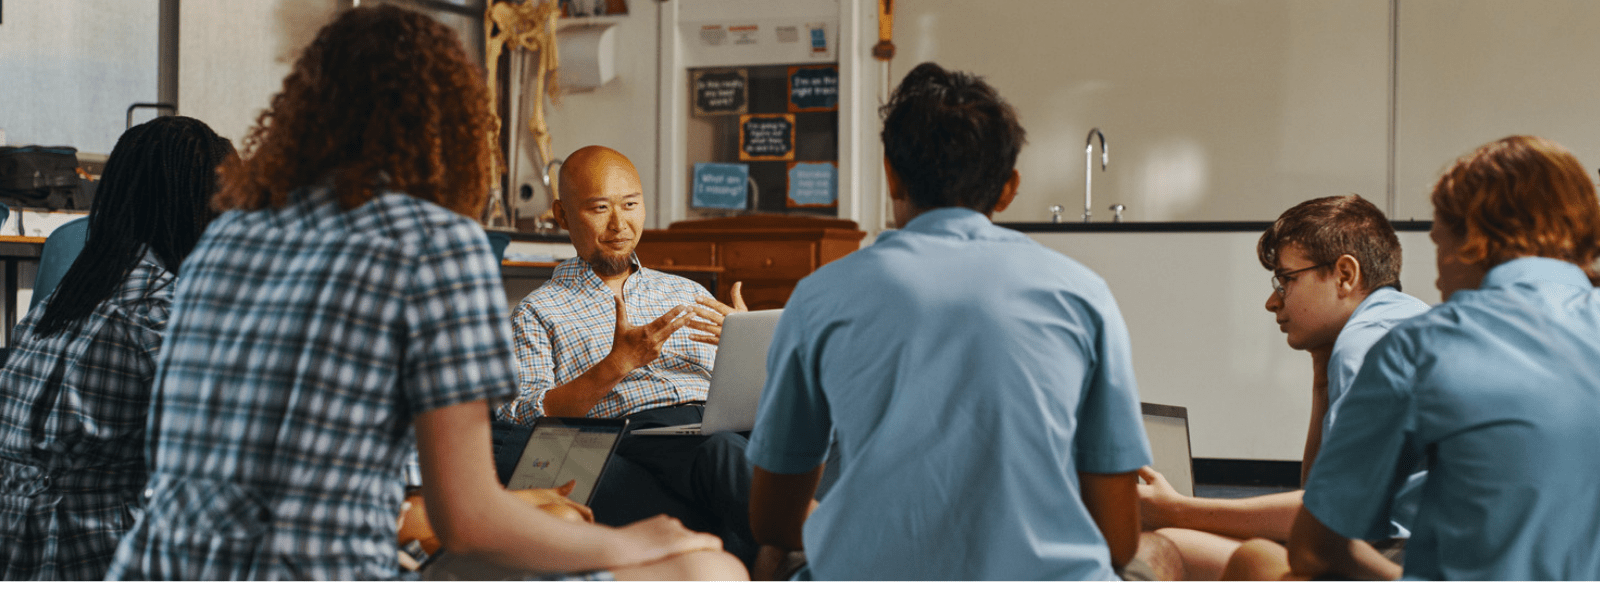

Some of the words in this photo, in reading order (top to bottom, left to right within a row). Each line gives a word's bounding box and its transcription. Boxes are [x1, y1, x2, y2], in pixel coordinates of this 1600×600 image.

[702, 174, 724, 183] What
[727, 176, 741, 184] am
[706, 185, 743, 196] missing?
